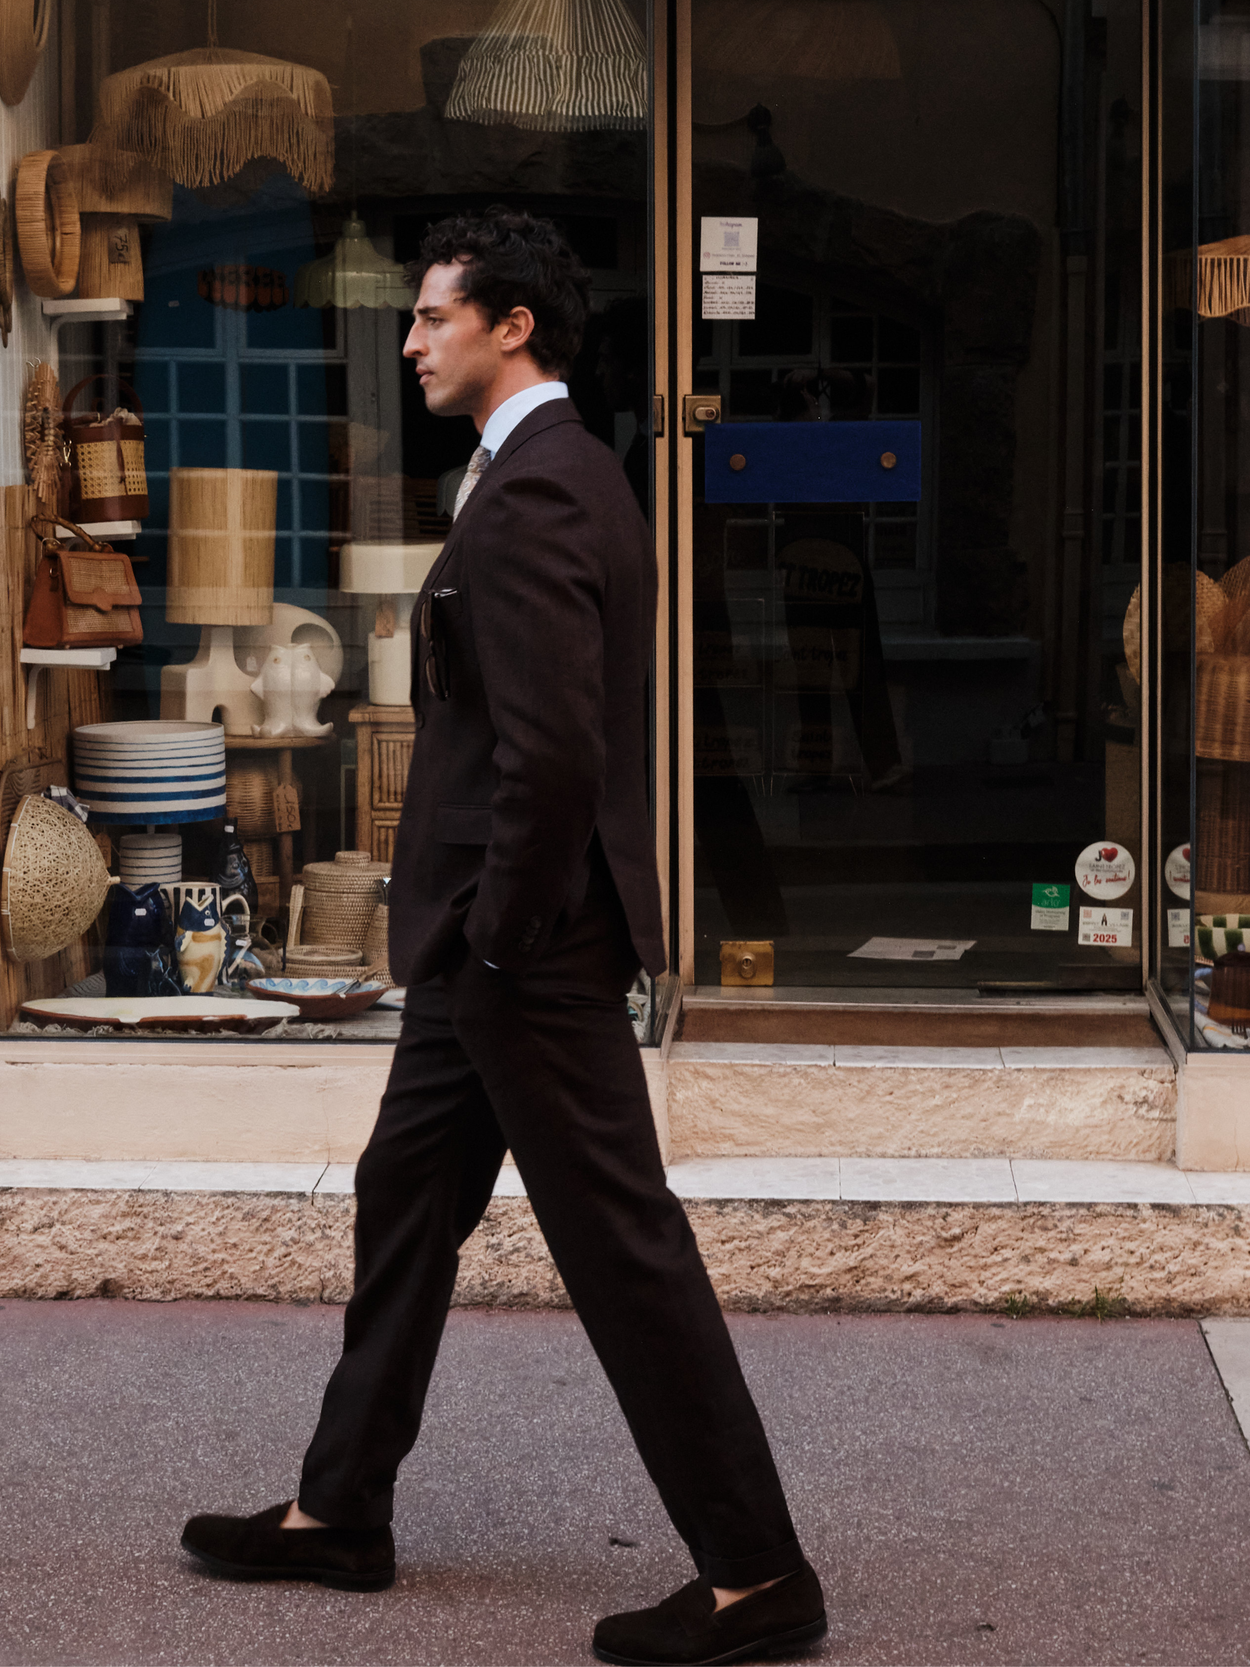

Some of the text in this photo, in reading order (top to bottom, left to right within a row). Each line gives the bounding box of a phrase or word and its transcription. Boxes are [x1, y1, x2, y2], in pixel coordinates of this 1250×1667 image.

[799, 565, 861, 598] TROPEZ
[1095, 850, 1101, 862] J
[1093, 933, 1118, 943] 2025
